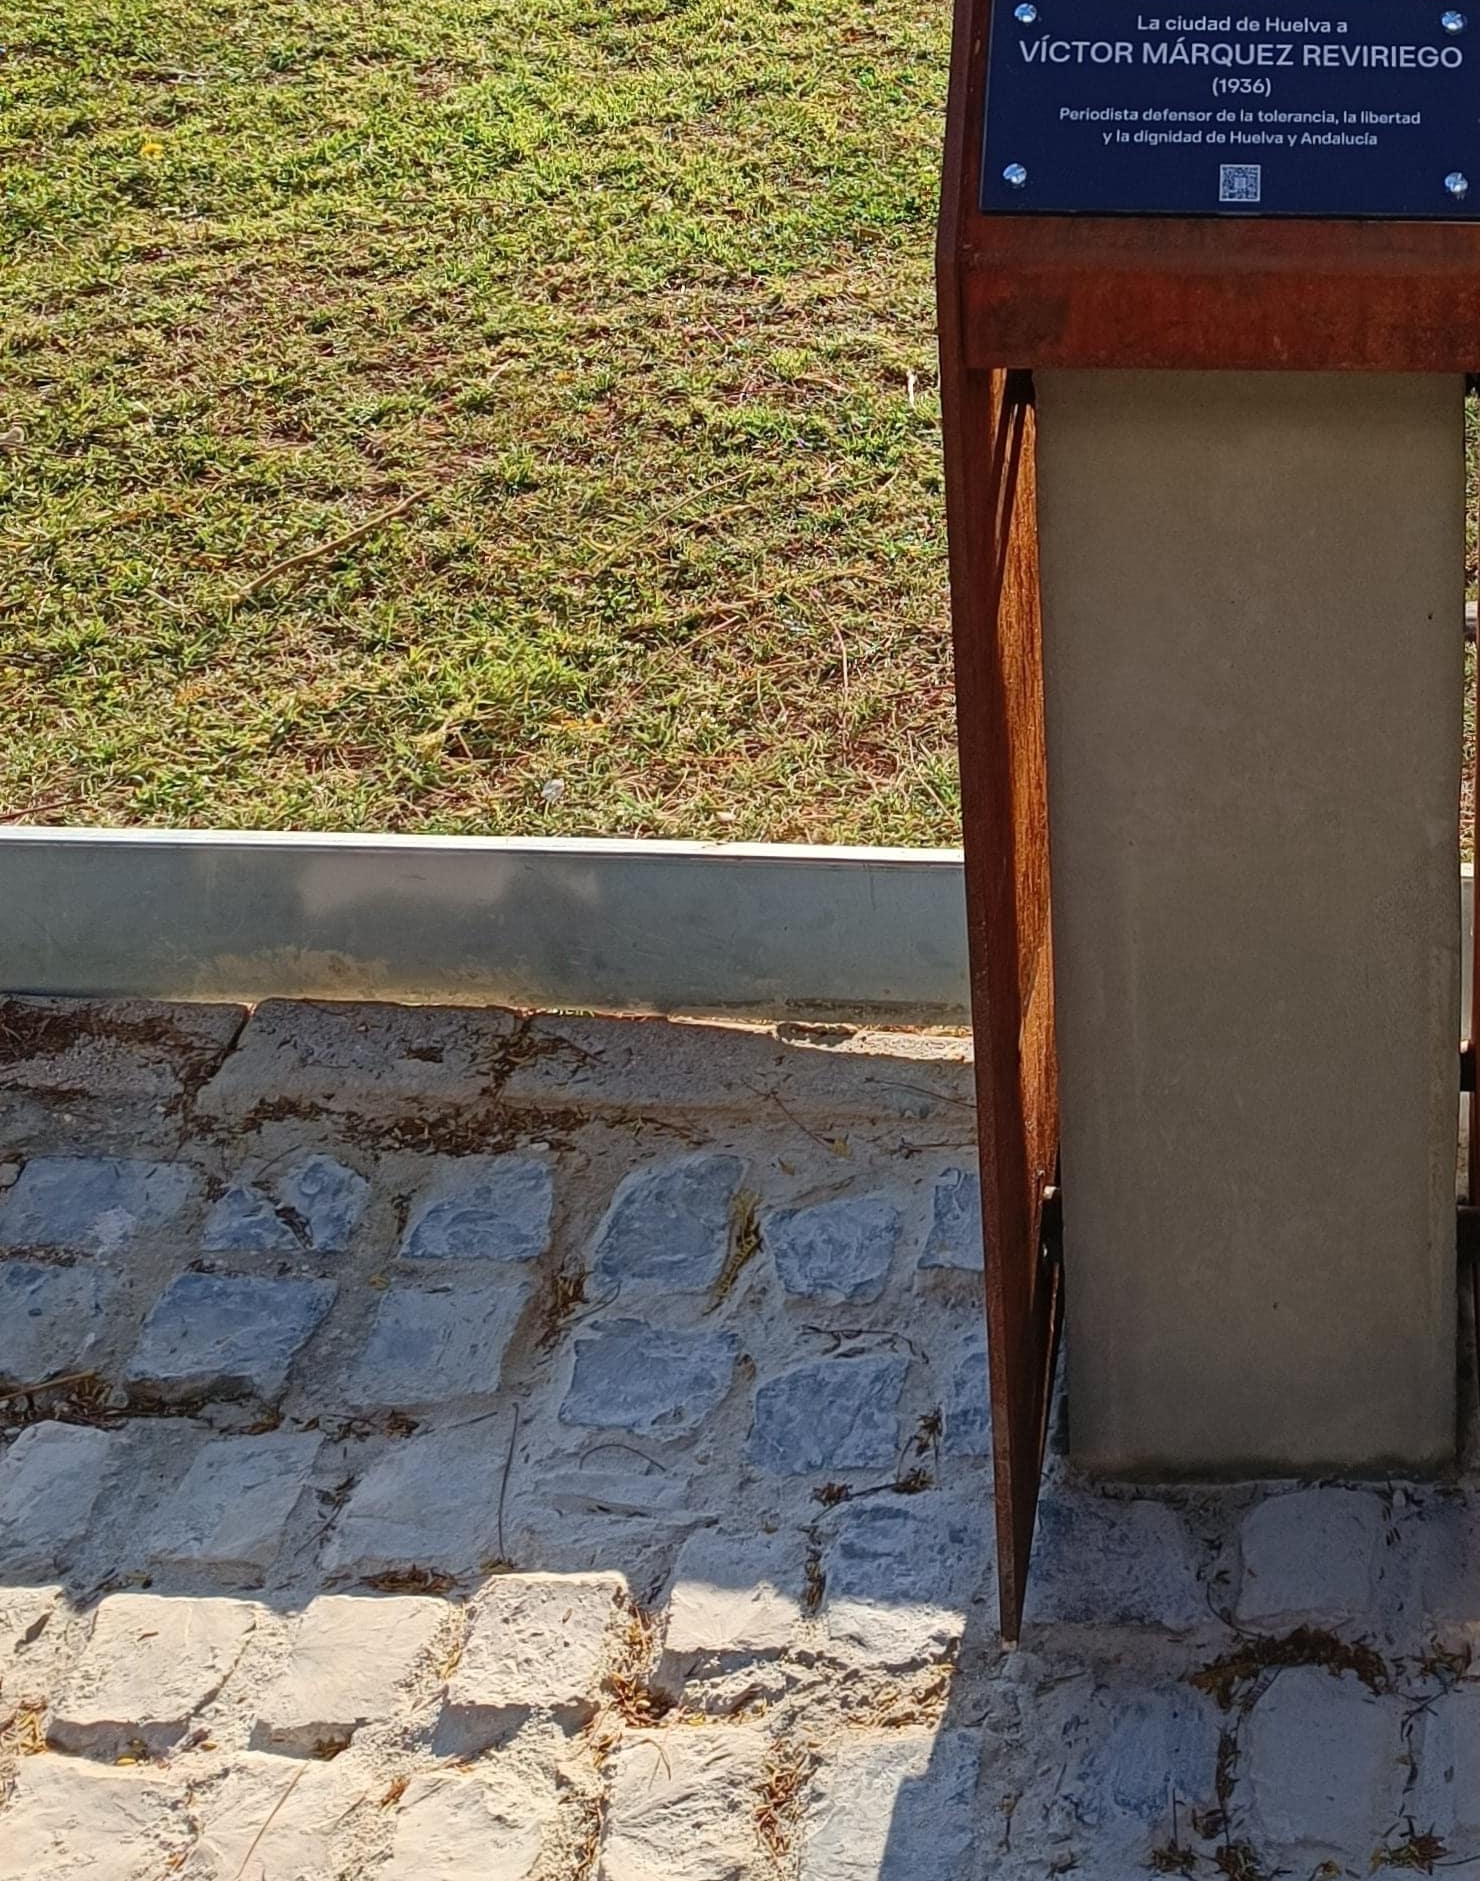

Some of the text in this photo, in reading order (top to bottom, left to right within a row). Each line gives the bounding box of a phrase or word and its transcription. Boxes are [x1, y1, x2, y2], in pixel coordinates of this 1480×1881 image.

[1137, 15, 1348, 33] La ciudad de Huelva a
[1019, 34, 1463, 68] VÍCTOR MÁRQUEZ REVIRIEGO
[1212, 76, 1272, 98] (1936)
[1059, 107, 1421, 125] Periodista defensor de la tolerancia, la libertad
[1102, 129, 1378, 147] y la dignidad de Huelva y Andalucía
